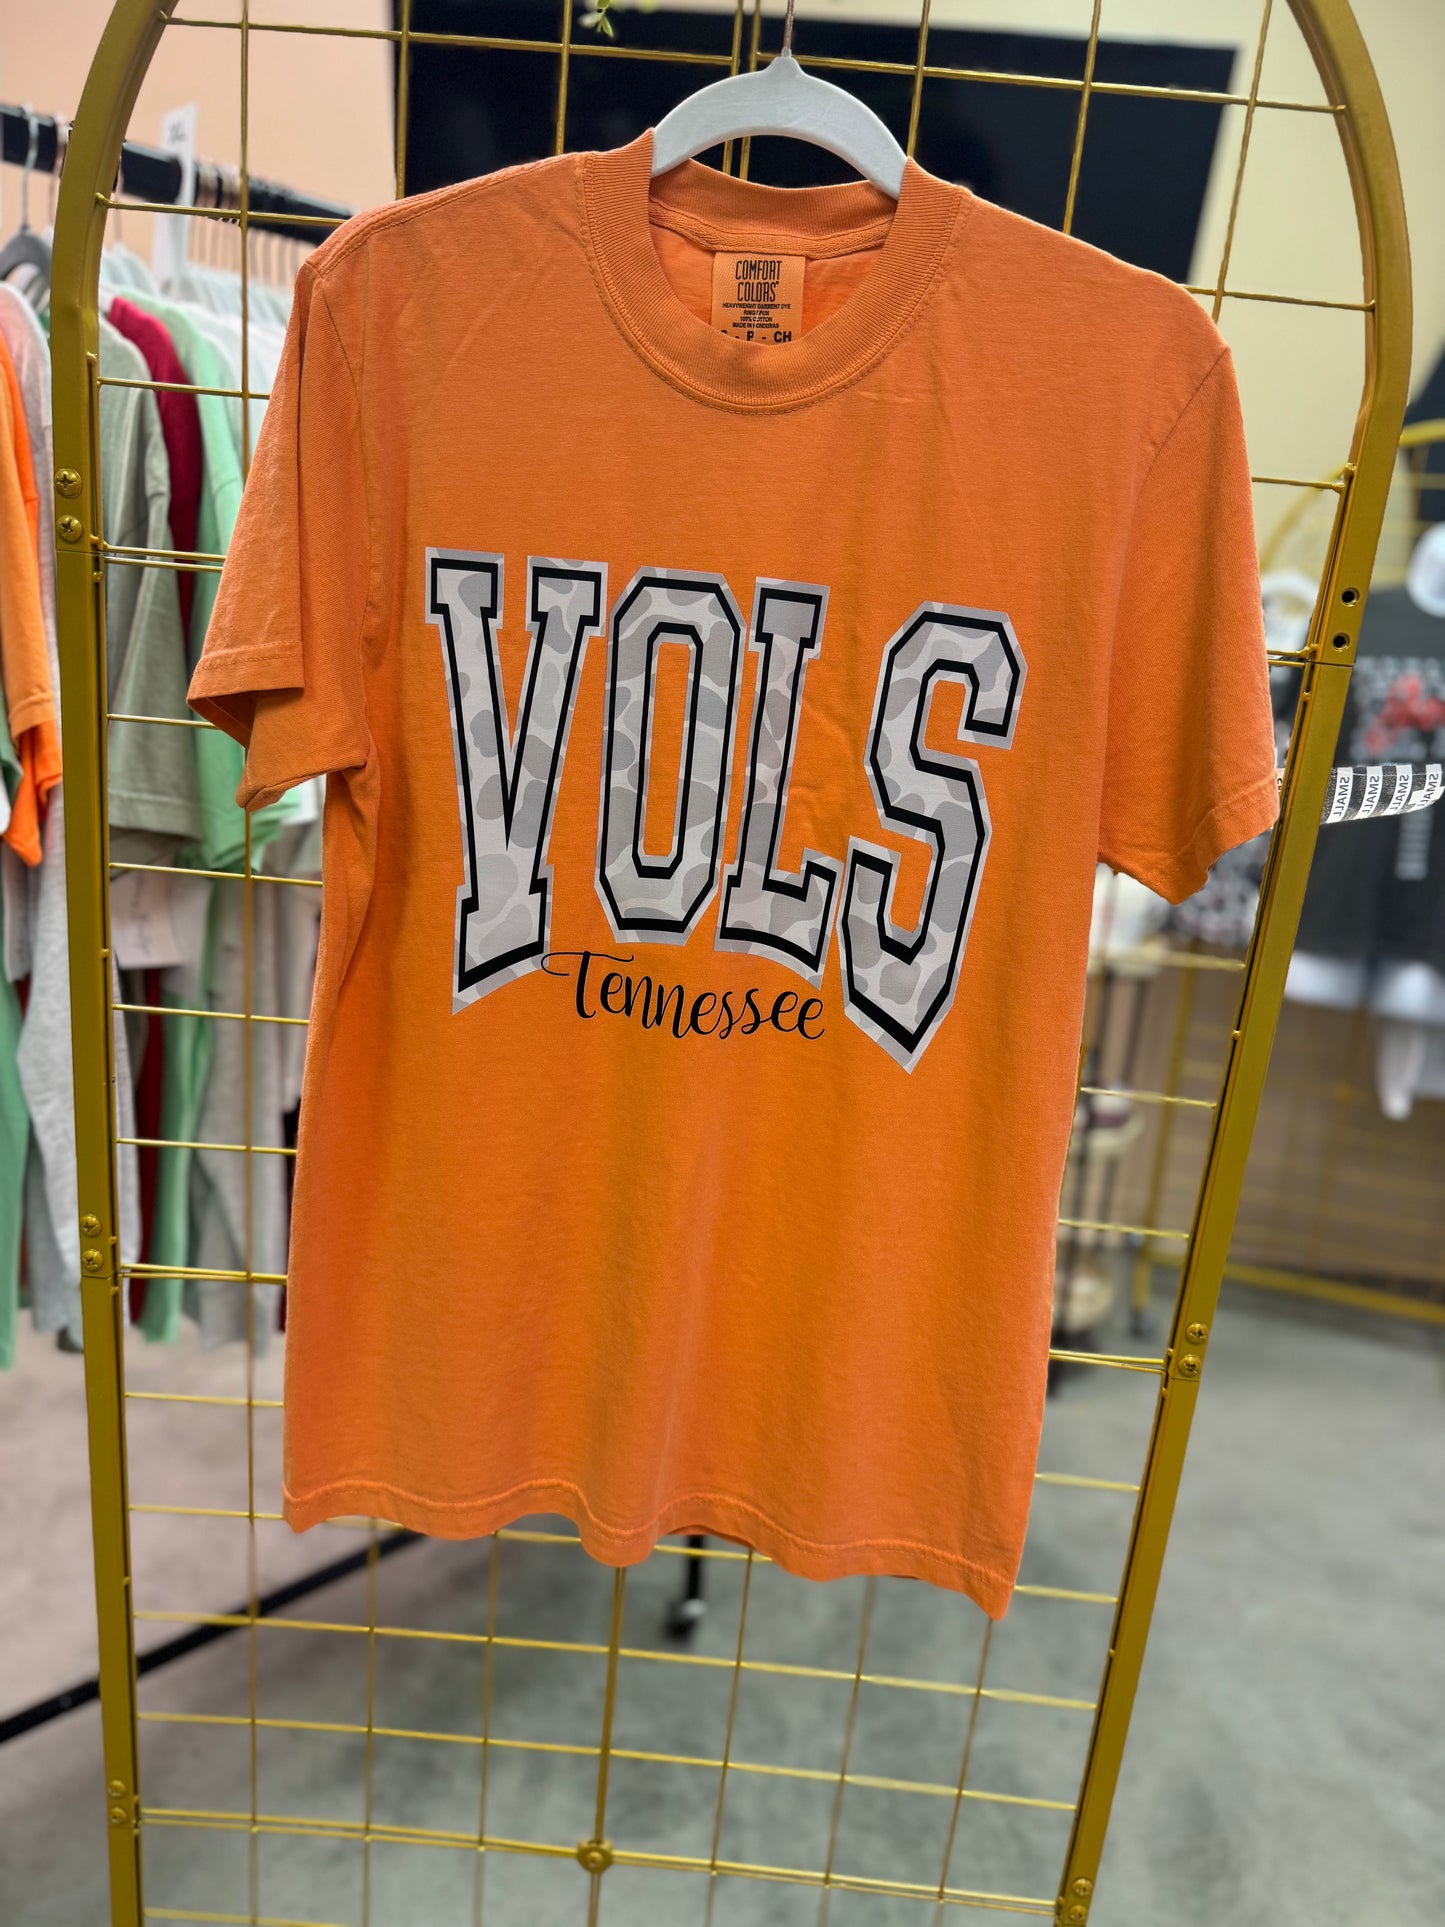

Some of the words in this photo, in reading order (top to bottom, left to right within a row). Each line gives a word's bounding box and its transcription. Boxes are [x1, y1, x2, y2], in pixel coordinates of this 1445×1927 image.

[735, 260, 782, 280] COMFORT
[773, 330, 792, 343] CH
[425, 547, 1028, 1075] VOLS
[540, 950, 826, 1040] Tennessee
